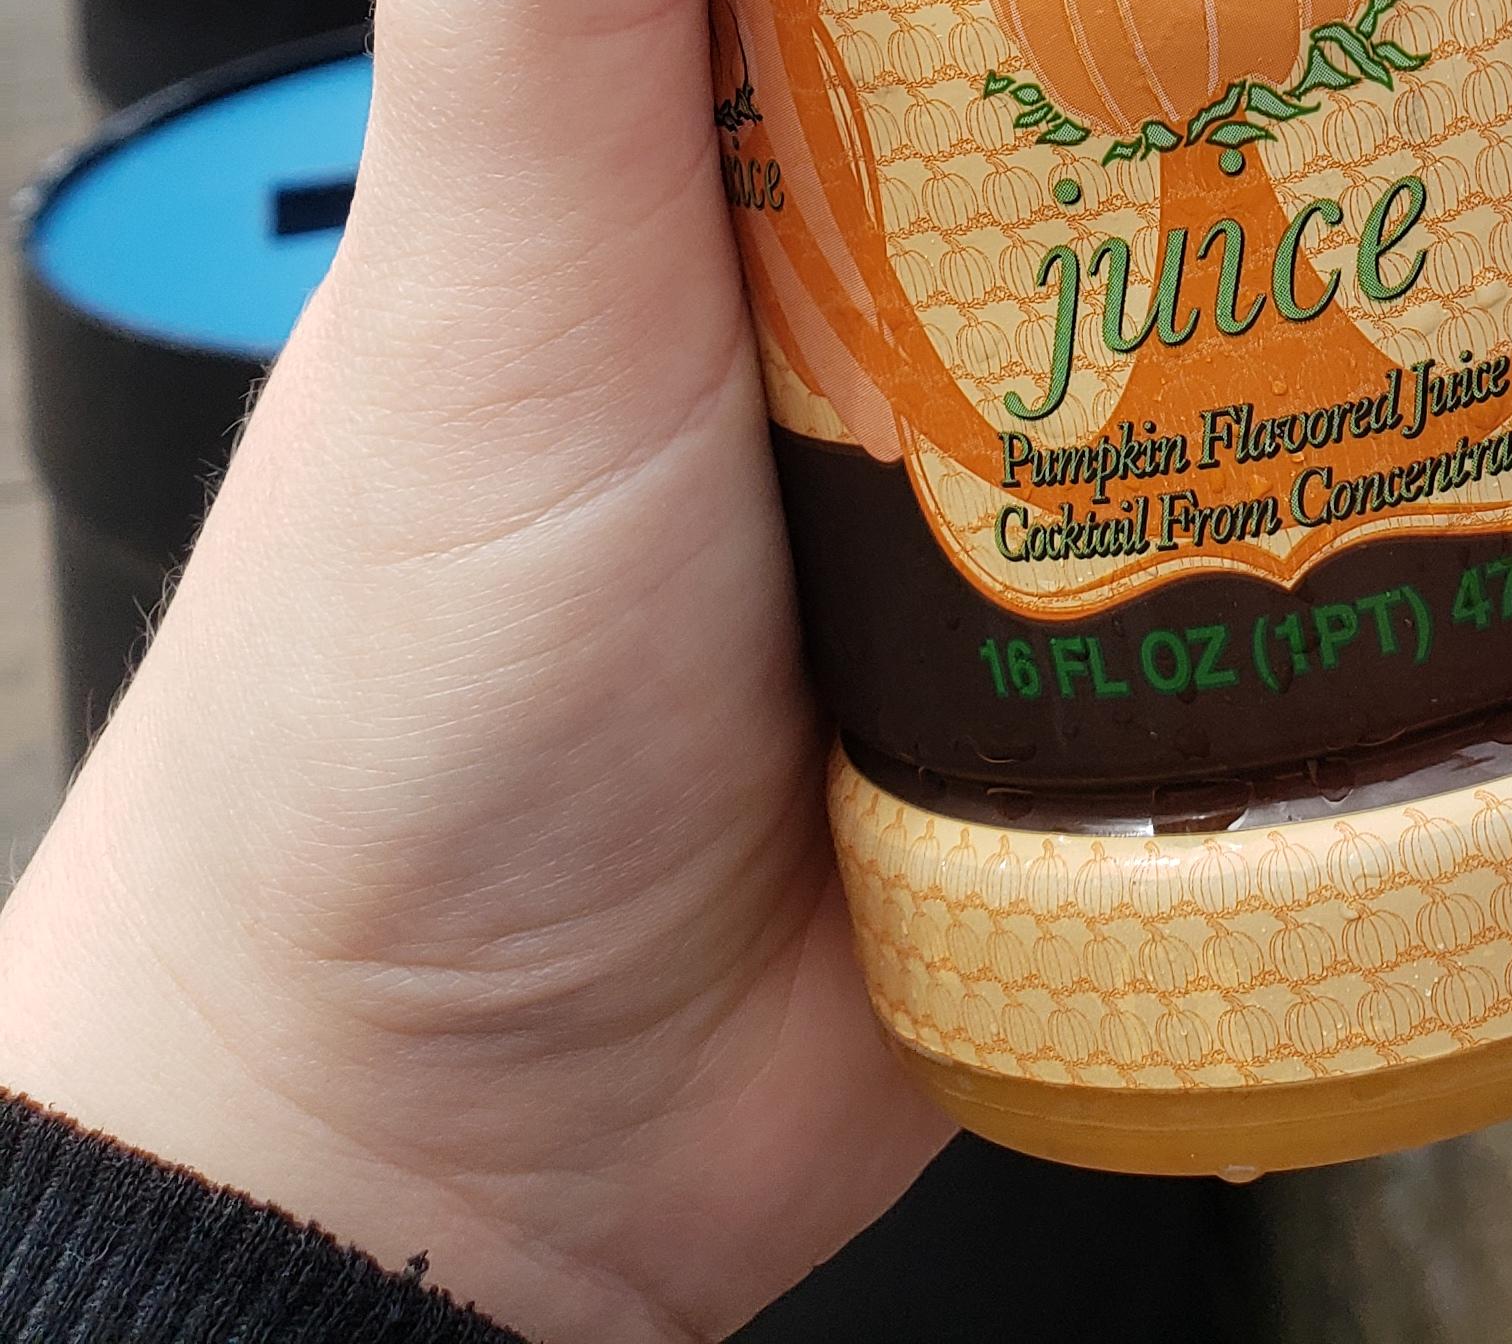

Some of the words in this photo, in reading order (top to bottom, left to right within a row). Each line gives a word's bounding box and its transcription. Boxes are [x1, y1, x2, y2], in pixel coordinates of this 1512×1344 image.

[1003, 147, 1429, 421] juice
[998, 420, 1189, 505] Pumpkin
[1198, 368, 1402, 471] Flavored
[1405, 350, 1512, 438] Juice
[994, 496, 1150, 563] Cocktail
[1158, 488, 1284, 552] From
[980, 634, 1043, 701] 16
[1050, 632, 1130, 700] FL
[1139, 625, 1241, 694] OZ
[1252, 584, 1434, 694] (1PT)
